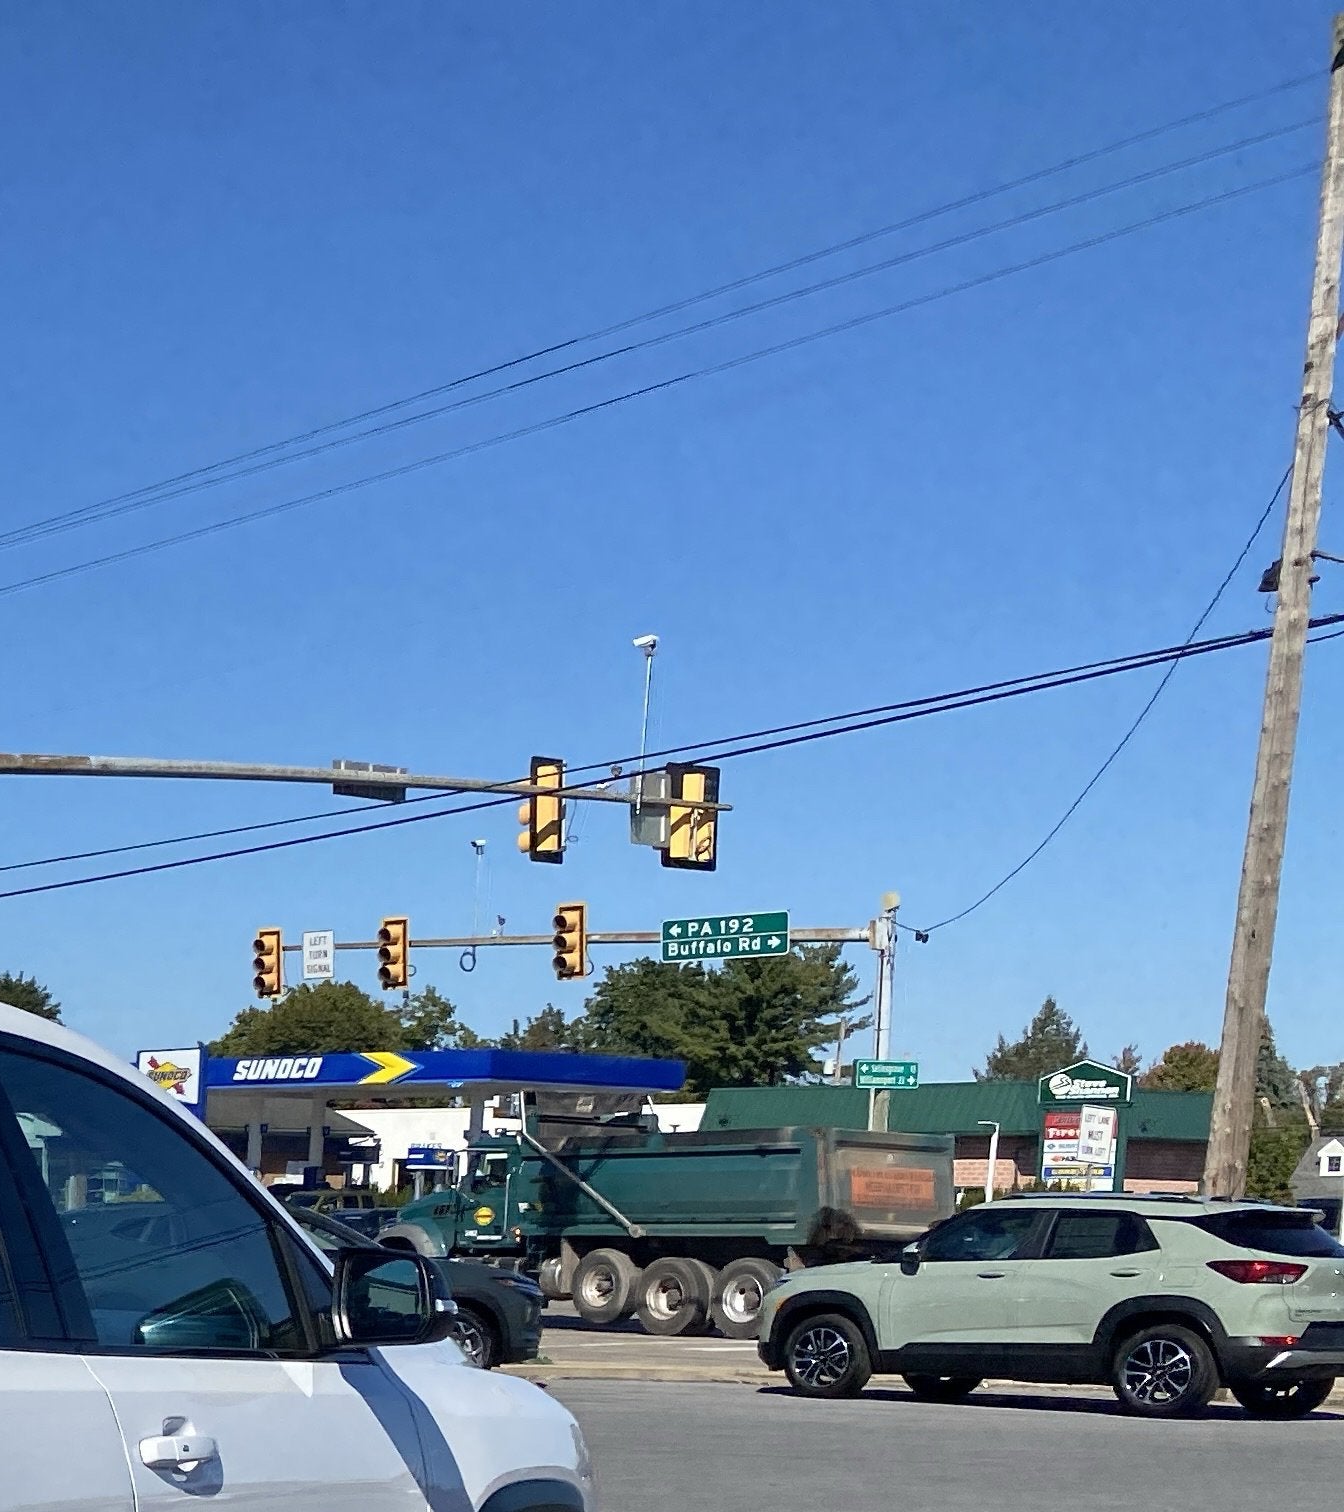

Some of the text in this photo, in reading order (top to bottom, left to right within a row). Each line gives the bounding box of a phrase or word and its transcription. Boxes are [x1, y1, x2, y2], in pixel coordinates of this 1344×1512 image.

[687, 918, 754, 937] PA 192
[309, 936, 328, 946] LEFT
[667, 936, 761, 957] Buffalo Rd
[309, 949, 328, 960] TURN
[306, 963, 331, 974] SIGNAL
[147, 1067, 190, 1083] SUNOCO
[232, 1057, 324, 1081] SUNOCO
